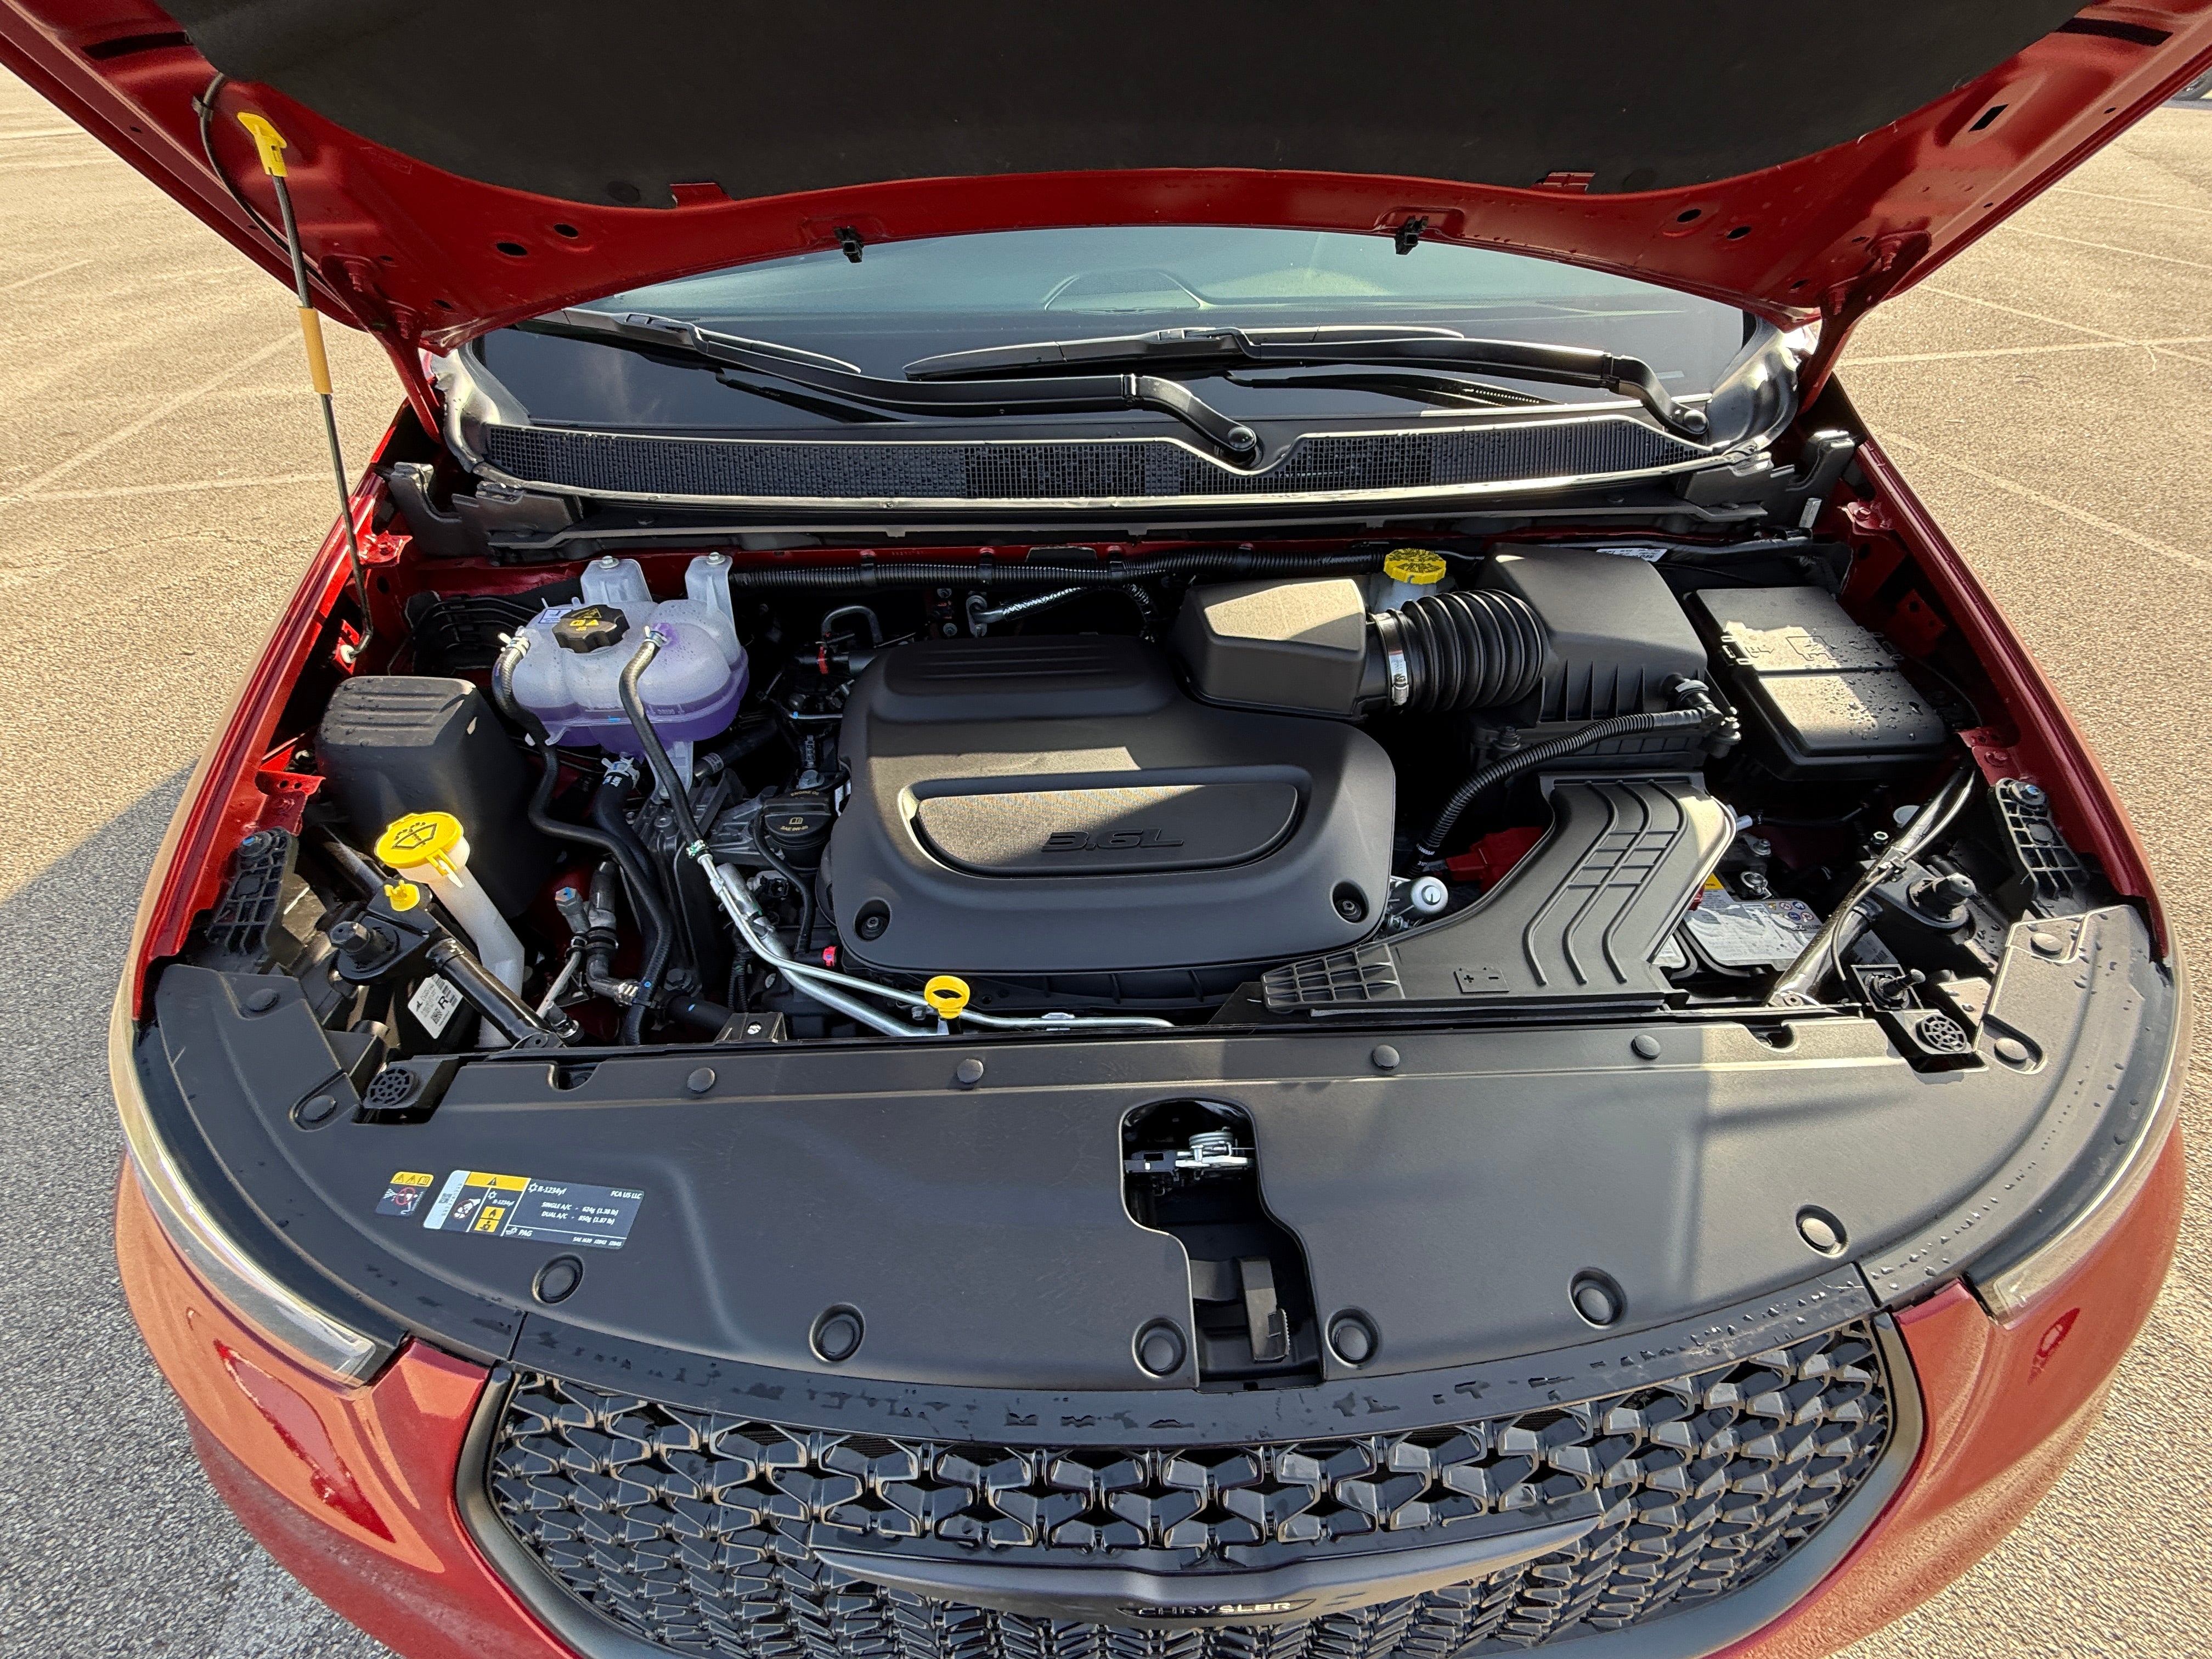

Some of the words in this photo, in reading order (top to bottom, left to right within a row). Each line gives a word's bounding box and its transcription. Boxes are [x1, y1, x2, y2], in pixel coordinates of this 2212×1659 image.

[1041, 827, 1184, 853] 3.6L
[438, 996, 449, 1009] R
[538, 1186, 567, 1196] R-1234yf
[518, 1229, 533, 1237] PAG
[1138, 1602, 1291, 1615] CHRYSLER
